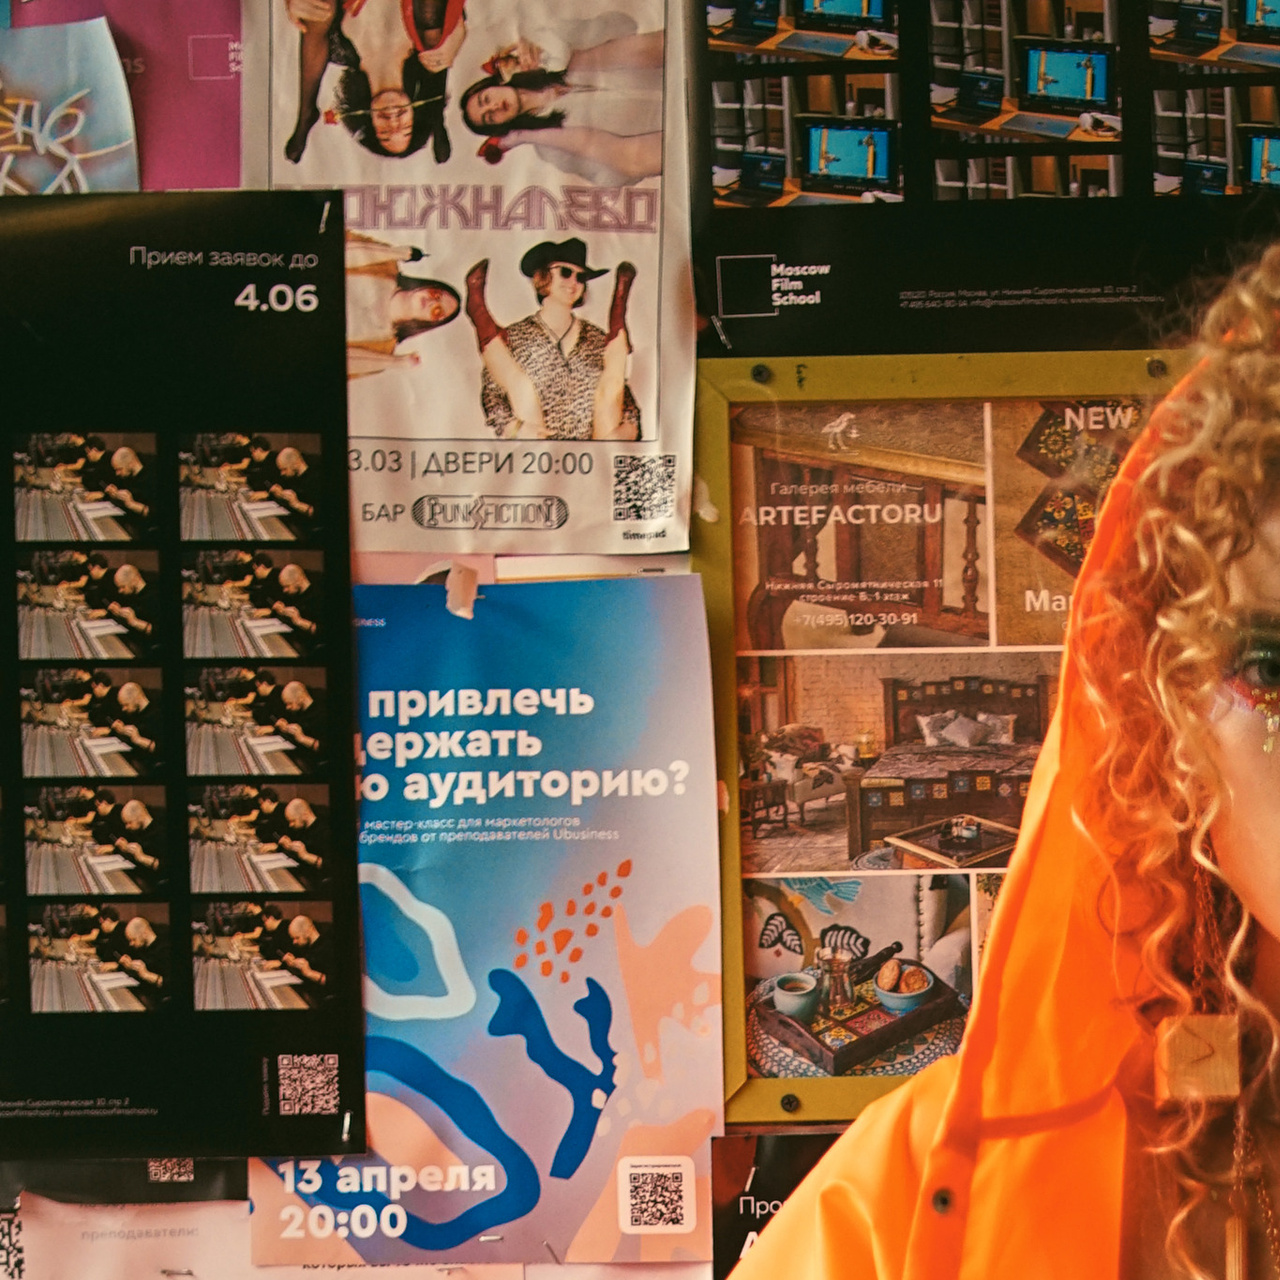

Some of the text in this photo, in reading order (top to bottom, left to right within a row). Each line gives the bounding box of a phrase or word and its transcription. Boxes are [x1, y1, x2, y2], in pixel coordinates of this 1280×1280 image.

[129, 245, 320, 272] Прием заявок до
[771, 262, 831, 278] Moscow
[771, 278, 804, 292] Film
[234, 283, 320, 313] 4.06
[771, 290, 822, 307] School
[1064, 407, 1133, 431] NEW
[421, 451, 514, 477] ДВЕРИ
[522, 451, 594, 475] 20:00
[770, 482, 840, 498] Галерея
[361, 503, 406, 523] БАР
[738, 503, 943, 526] ARTEFACTORU
[368, 688, 595, 726] привлечь
[403, 759, 691, 808] аудиторию?
[277, 1160, 496, 1199] 13 апреля
[278, 1203, 409, 1240] 20:00
